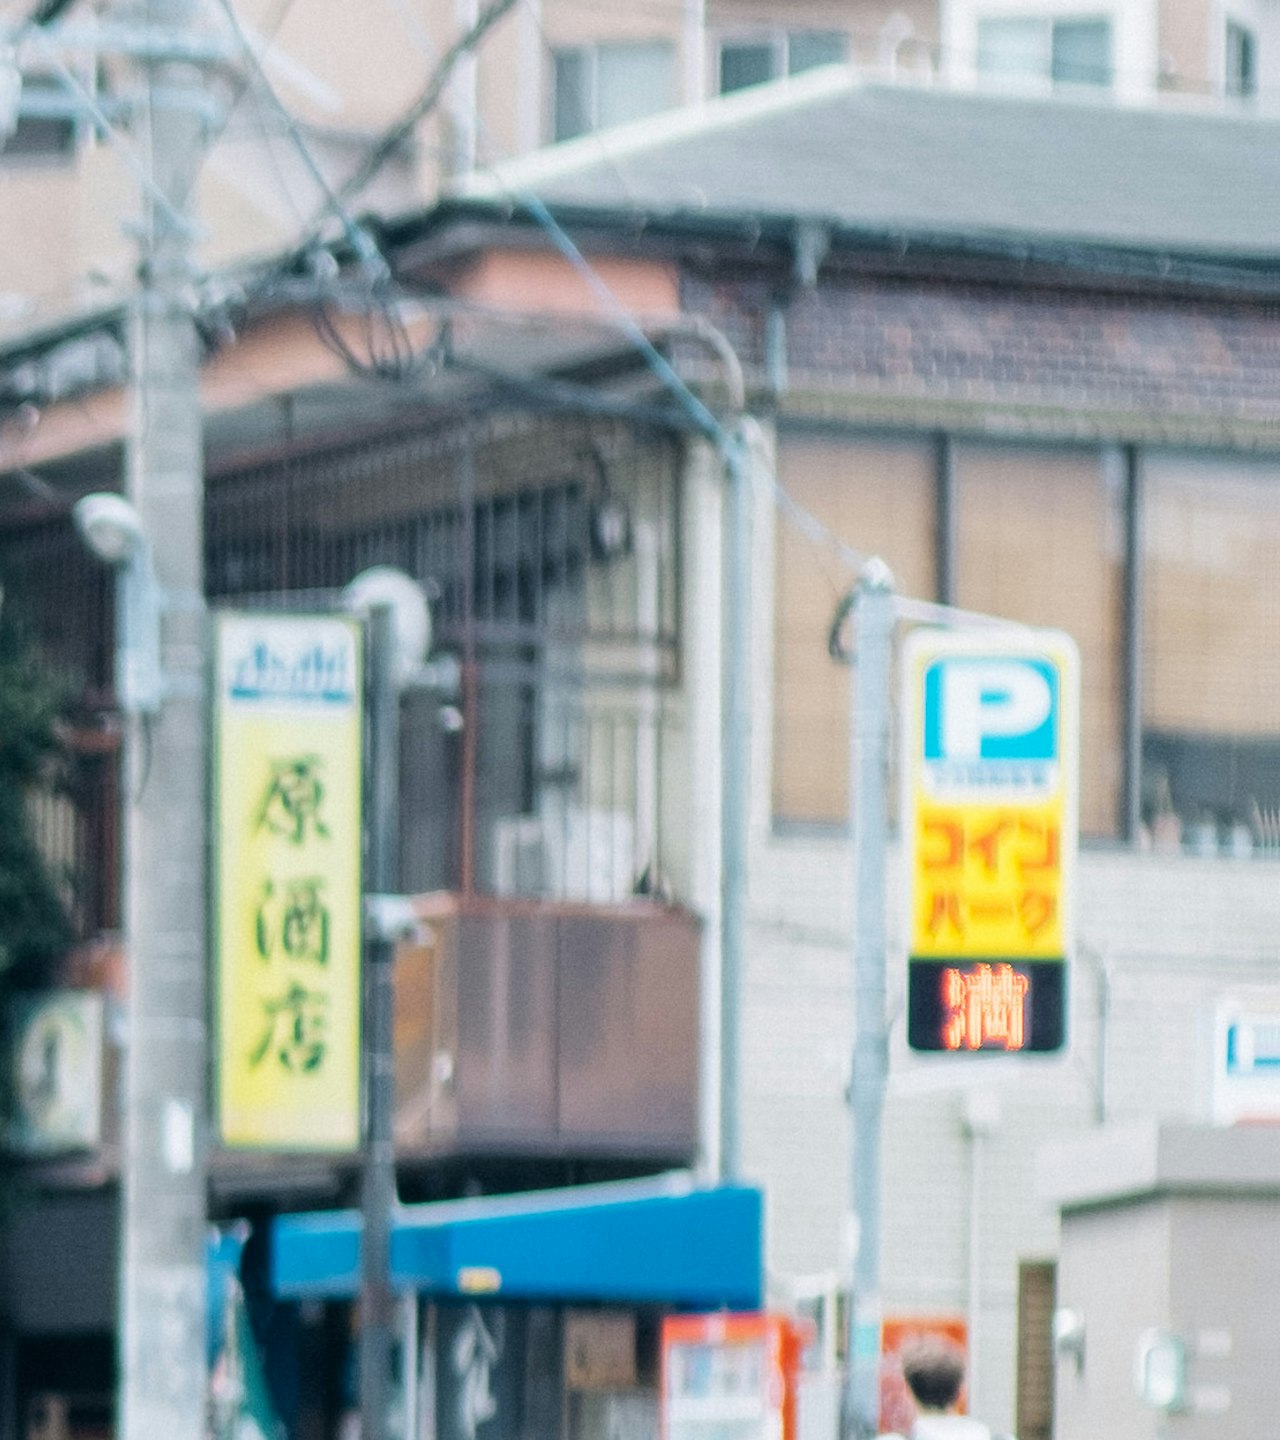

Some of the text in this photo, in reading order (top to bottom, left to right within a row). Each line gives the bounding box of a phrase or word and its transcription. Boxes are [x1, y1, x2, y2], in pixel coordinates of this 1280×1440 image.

[941, 659, 1053, 762] P
[921, 816, 1057, 874] コイン
[251, 750, 332, 1076] 原酒店
[944, 962, 1028, 1051] 満
